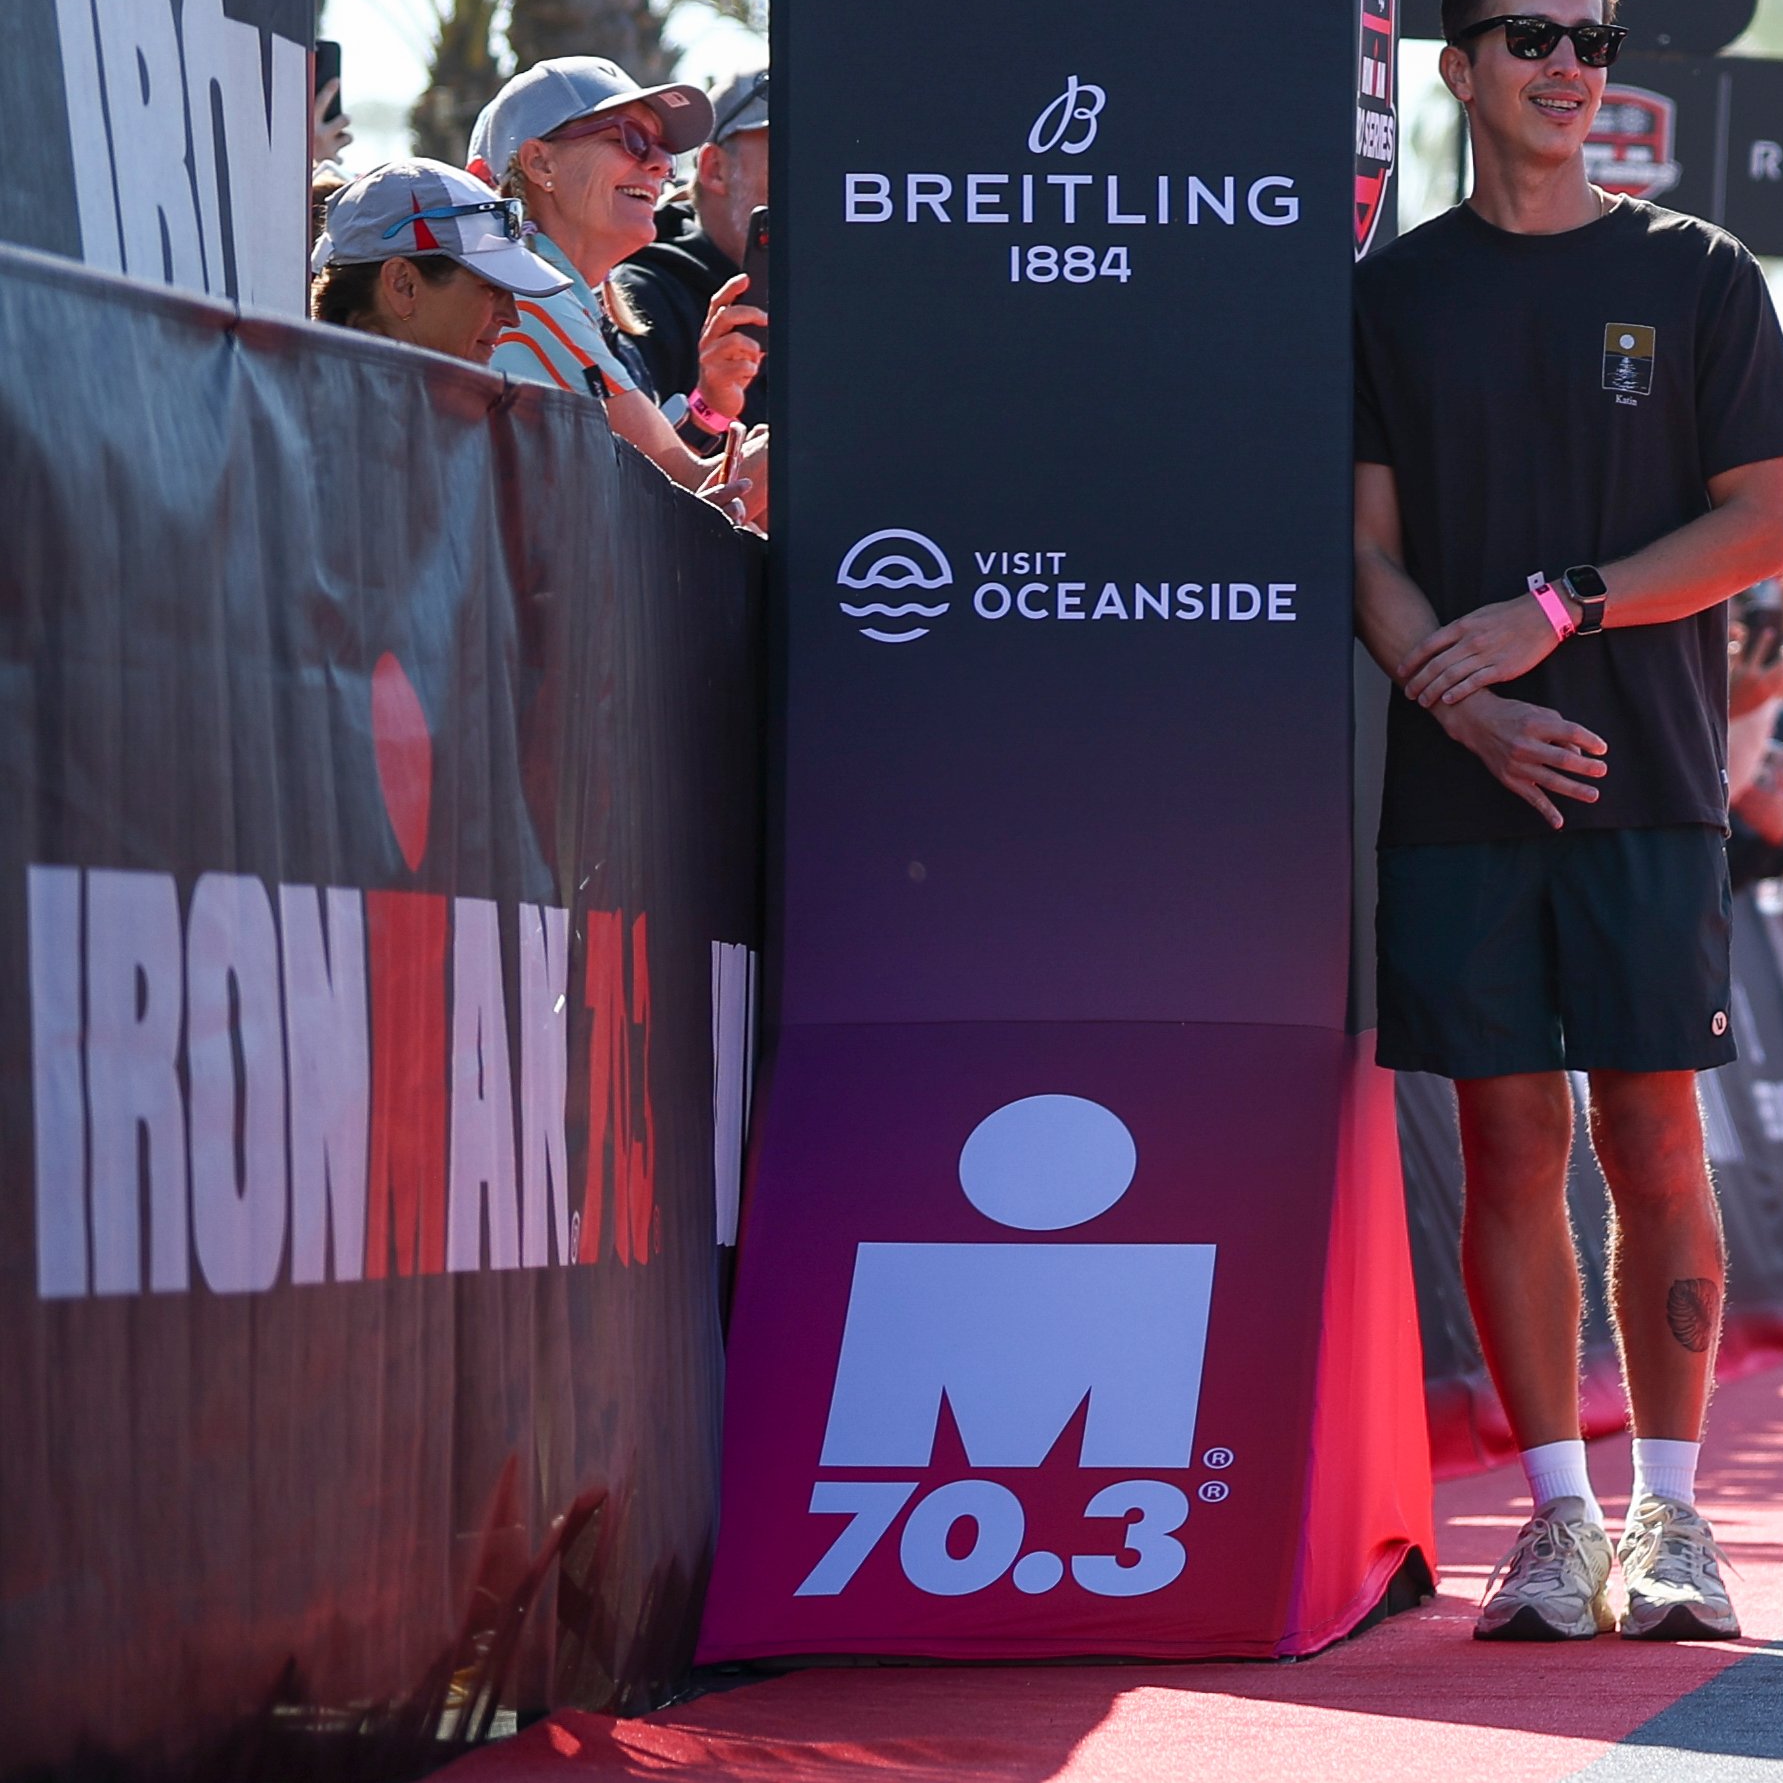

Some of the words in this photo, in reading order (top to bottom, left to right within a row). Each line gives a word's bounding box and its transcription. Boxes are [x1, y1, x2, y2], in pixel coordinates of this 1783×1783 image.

[844, 172, 1299, 226] BREITLING
[1009, 244, 1131, 283] 1884
[974, 551, 1066, 575] VISIT
[972, 582, 1296, 621] OCEANSIDE
[26, 863, 570, 1301] IRONMAN
[793, 1479, 1190, 1597] 70.3
